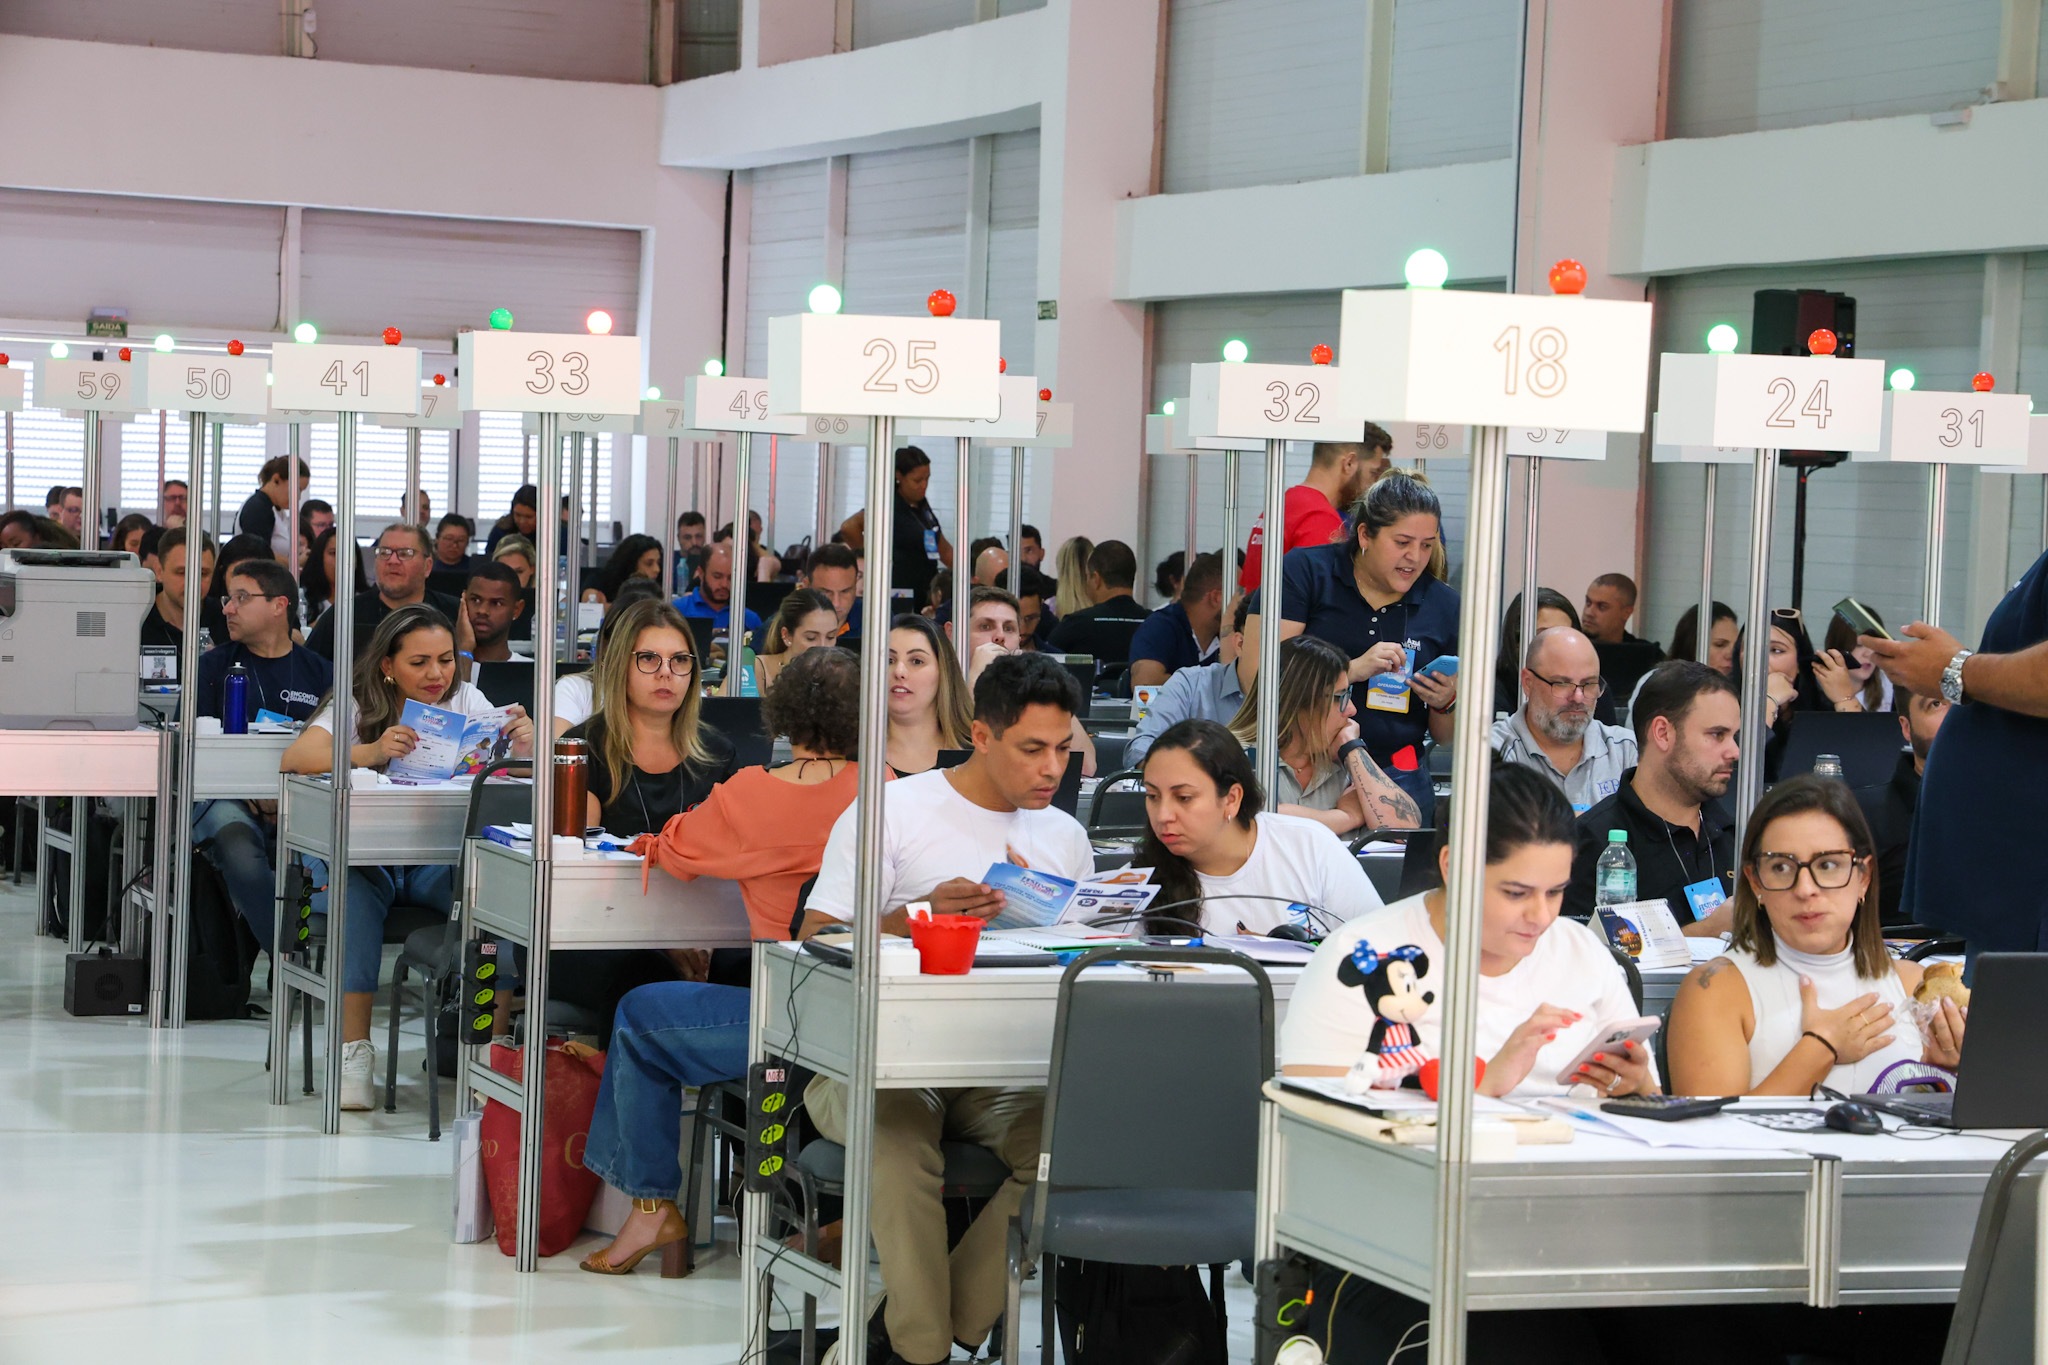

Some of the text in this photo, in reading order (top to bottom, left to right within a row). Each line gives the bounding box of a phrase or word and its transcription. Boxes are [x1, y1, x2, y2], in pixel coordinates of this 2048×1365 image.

[320, 360, 368, 396] 41
[526, 350, 590, 395] 33
[863, 338, 940, 394] 25
[1493, 325, 1568, 398] 18
[77, 372, 121, 400] 59
[186, 367, 231, 400] 50
[666, 408, 684, 429] 7
[729, 389, 768, 420] 49
[1264, 381, 1320, 423] 32
[1766, 377, 1832, 429] 24
[815, 416, 849, 434] 66
[1415, 424, 1449, 449] 56
[1938, 408, 1985, 448] 31
